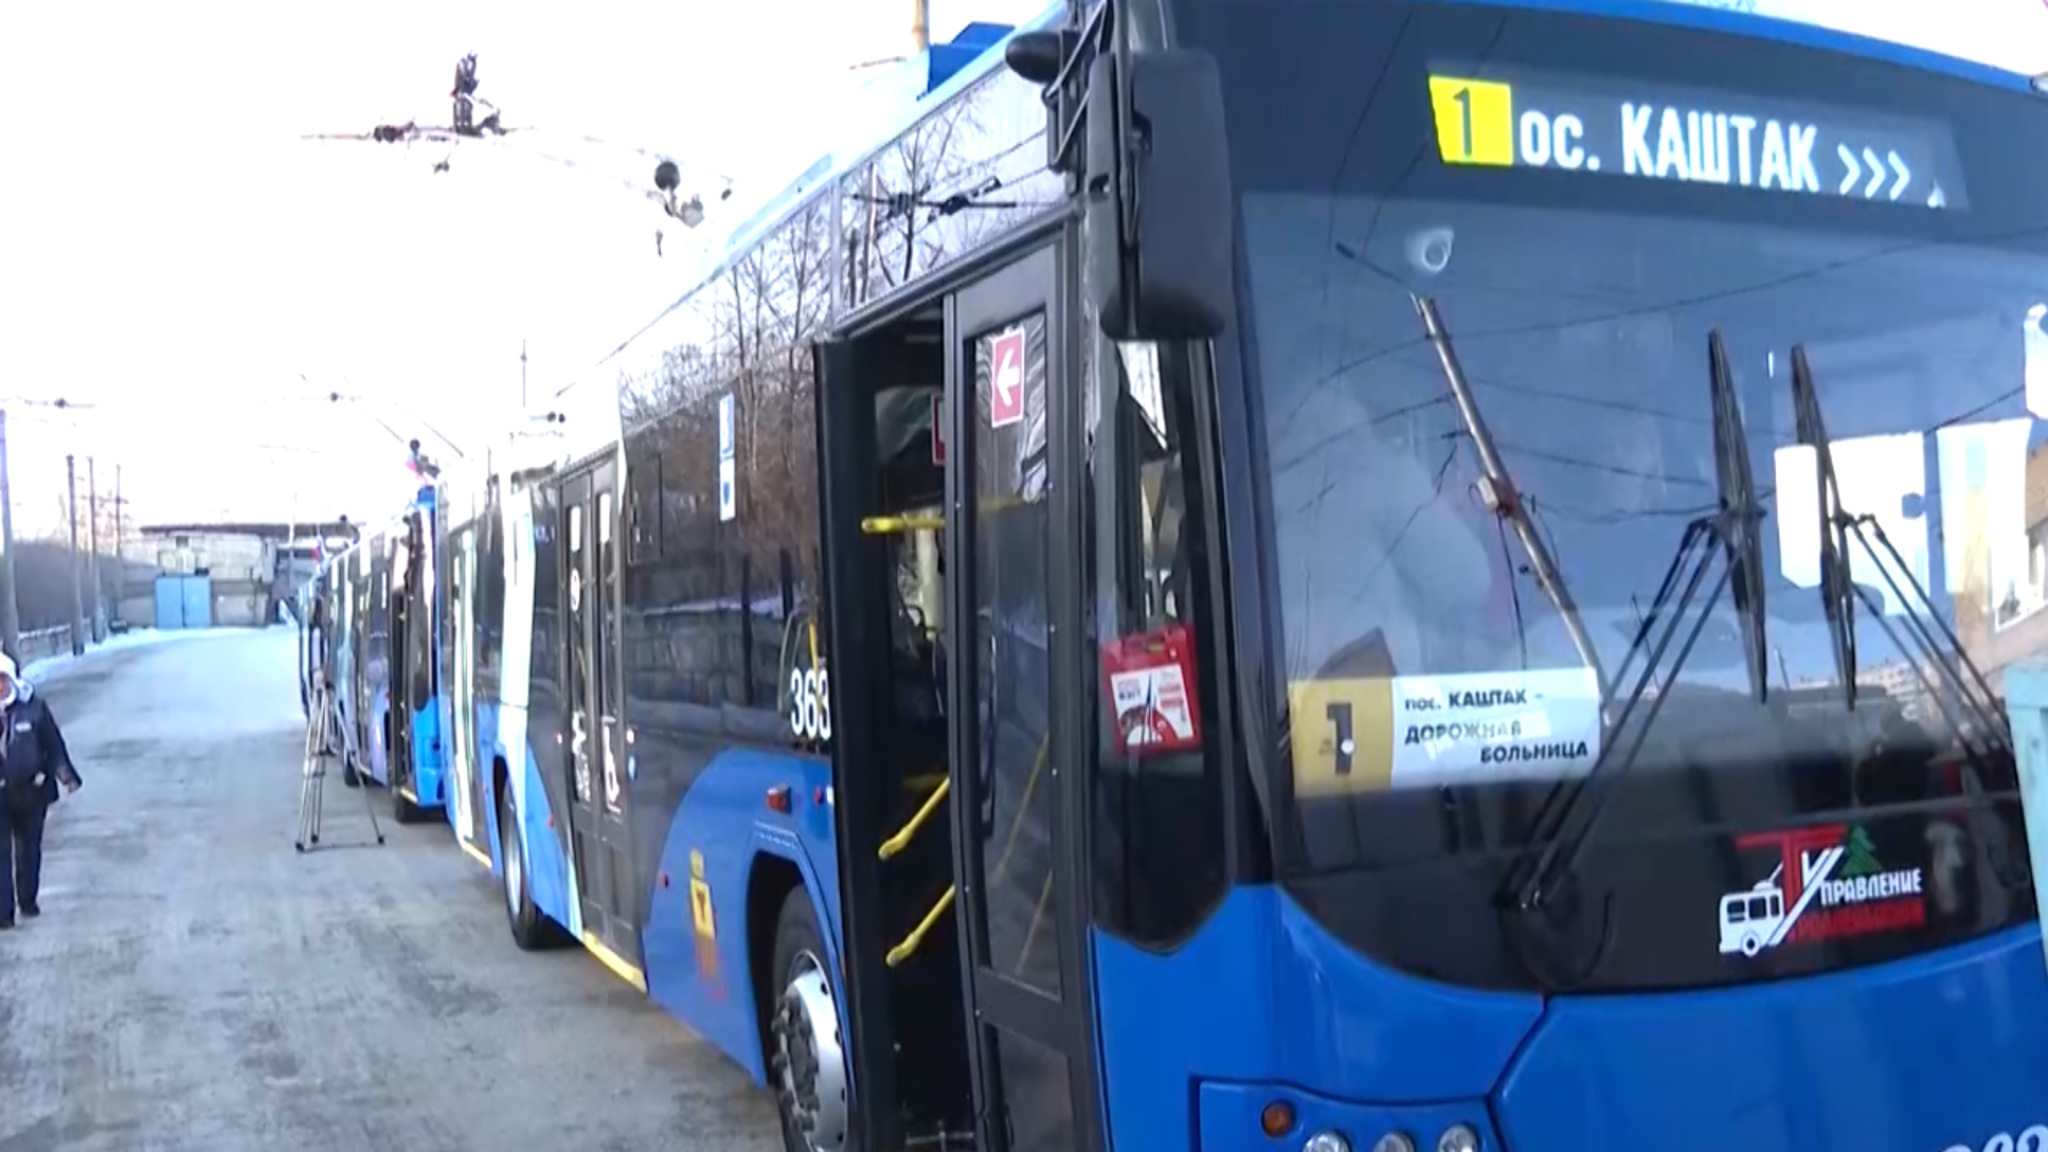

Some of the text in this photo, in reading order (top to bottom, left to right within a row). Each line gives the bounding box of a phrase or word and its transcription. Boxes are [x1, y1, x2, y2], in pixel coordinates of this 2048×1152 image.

[1452, 86, 1475, 161] 1
[1621, 102, 1819, 193] КАШТАК
[1404, 696, 1442, 712] пос.
[1448, 688, 1528, 708] КАШТАК
[1326, 702, 1353, 776] 1
[1404, 718, 1523, 746] ДОРОЖНАЯ
[1480, 740, 1589, 764] БОЛЬНИЦА
